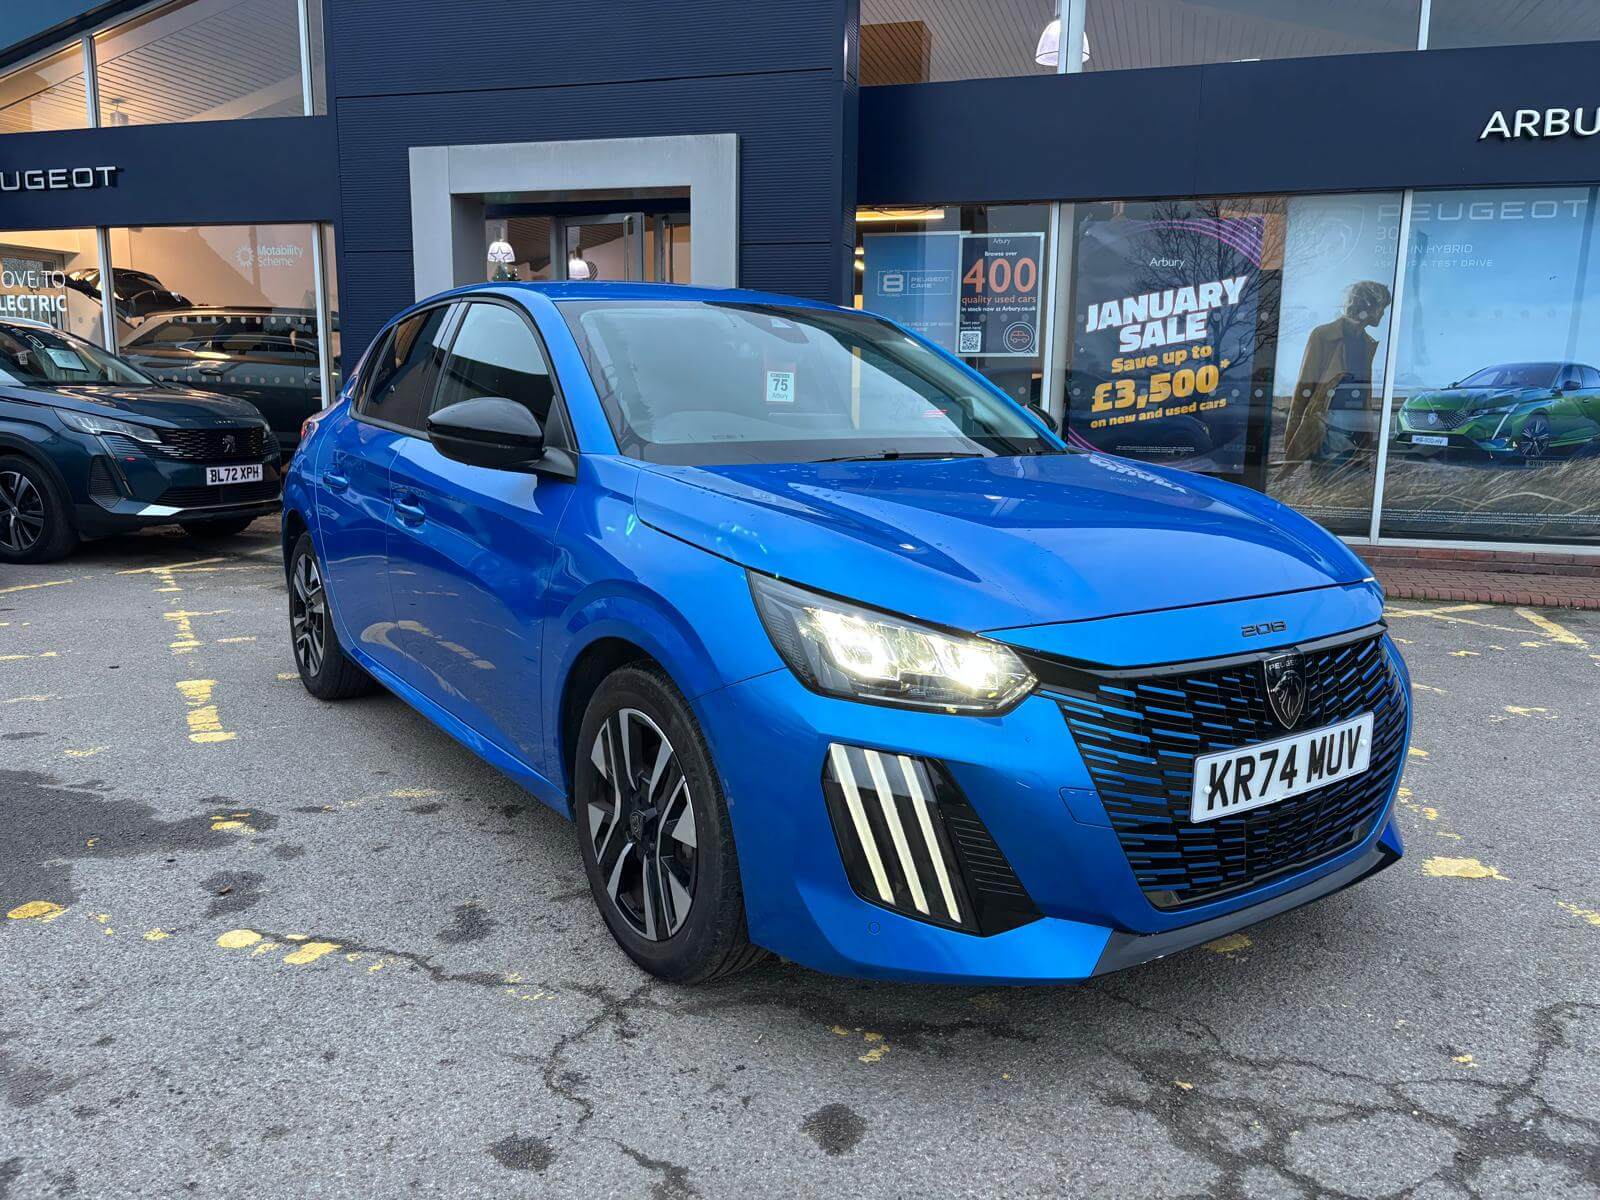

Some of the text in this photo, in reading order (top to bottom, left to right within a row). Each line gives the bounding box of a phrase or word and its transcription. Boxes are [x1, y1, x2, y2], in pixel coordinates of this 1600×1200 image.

[1480, 107, 1600, 139] ARBU
[0, 166, 116, 191] UGEOT
[1378, 199, 1588, 222] PEUGEOT
[257, 245, 304, 258] Motability
[1427, 243, 1473, 254] HYBRID
[257, 256, 293, 267] Scheme
[1150, 257, 1185, 270] Arbury
[1432, 259, 1456, 268] TEST
[1460, 259, 1493, 268] DRIVE
[1, 270, 66, 289] OVE TO
[883, 274, 904, 292] 8
[963, 257, 1037, 293] 400
[0, 295, 67, 311] LECTRIC
[961, 294, 1037, 305] quality used cars
[1086, 275, 1248, 333] JANUARY
[1119, 311, 1208, 352] SALE
[1111, 345, 1213, 374] Save up to
[773, 379, 788, 391] 75
[1090, 397, 1227, 429] on new and used cars
[210, 466, 260, 483] BL72 XPH
[1241, 621, 1287, 637] 208
[1268, 658, 1298, 672] PEUGE
[1206, 725, 1362, 811] KR74 MUV
